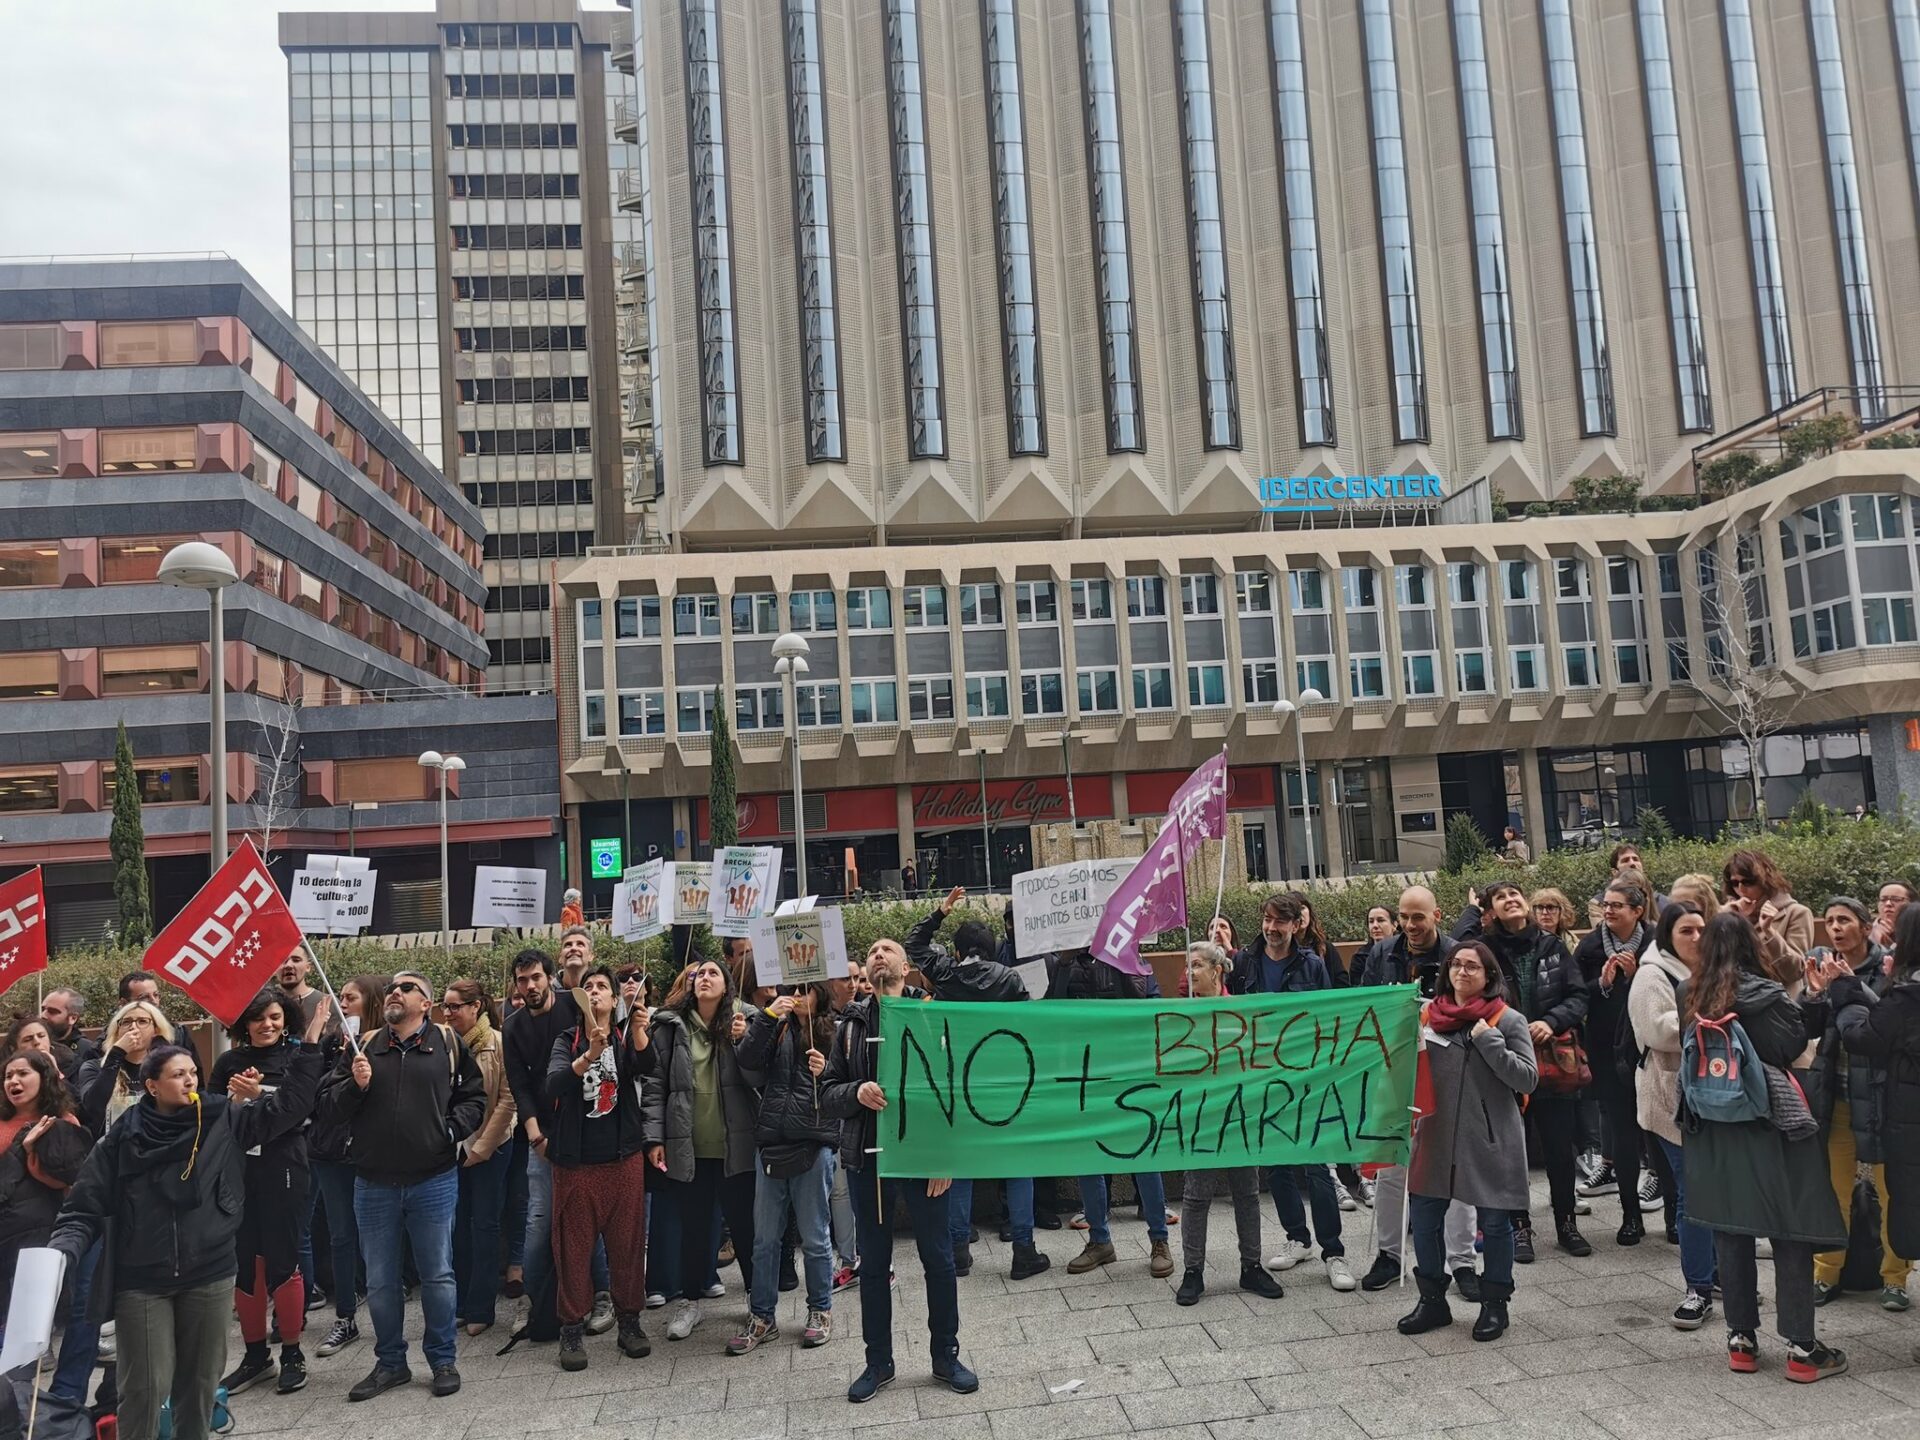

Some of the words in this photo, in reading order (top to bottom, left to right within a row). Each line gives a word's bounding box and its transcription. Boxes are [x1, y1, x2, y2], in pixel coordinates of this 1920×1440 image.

[1259, 475, 1441, 500] IBERCENTER
[914, 787, 1008, 834] Holiday
[1012, 780, 1064, 824] Gym
[299, 876, 310, 886] 10
[312, 877, 351, 887] deciden
[353, 878, 362, 887] la
[1016, 875, 1060, 897] TODOS
[1068, 868, 1118, 885] SOMOS
[348, 905, 369, 916] 1000
[1024, 909, 1071, 931] AUMENTOS
[775, 923, 799, 931] BRECHA
[1154, 1006, 1392, 1075] BRECHA
[898, 1017, 1036, 1143] NO
[1055, 1045, 1111, 1112] +
[1096, 1071, 1406, 1159] SALARIAL
